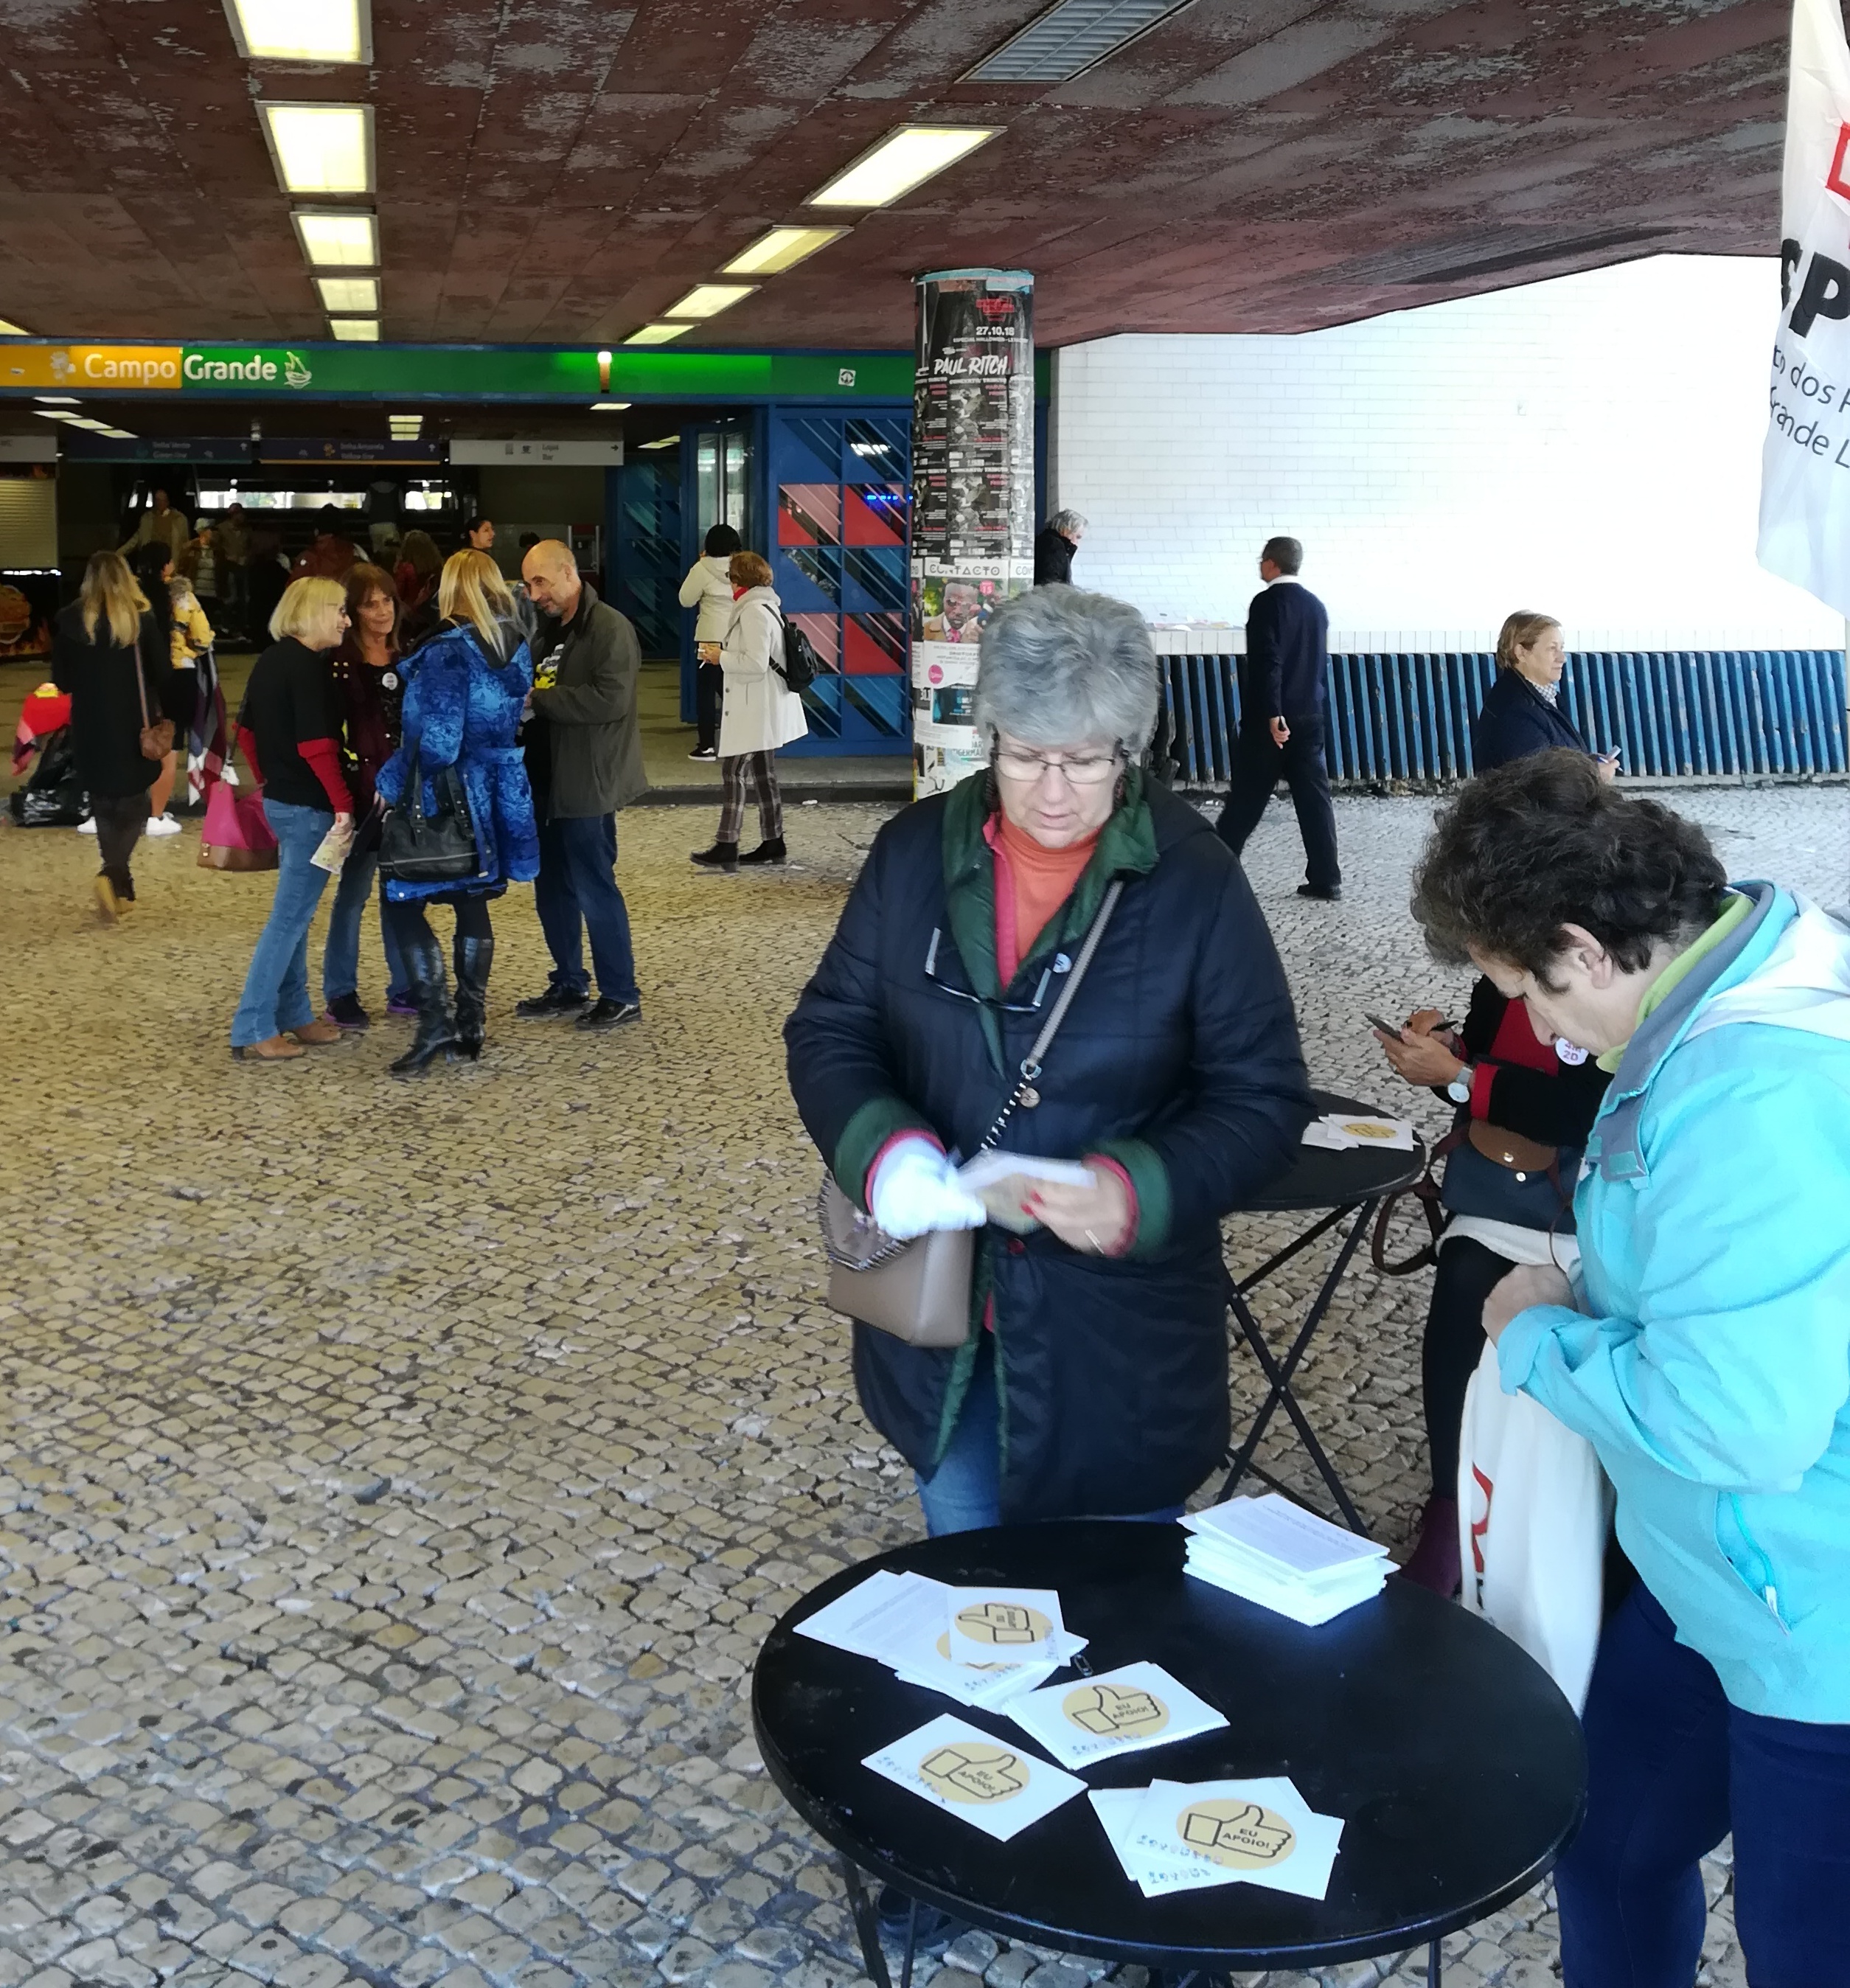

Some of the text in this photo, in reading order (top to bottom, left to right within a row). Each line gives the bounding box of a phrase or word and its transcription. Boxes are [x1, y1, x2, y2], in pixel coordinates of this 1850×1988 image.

[976, 326, 1015, 336] 27.10.18
[84, 353, 277, 386] Campo Grande
[933, 355, 1008, 375] PAUL RITCH
[1790, 362, 1836, 404] dos
[929, 564, 1000, 575] COTACTO
[1563, 1050, 1579, 1061] 2D
[976, 1770, 993, 1781] EU
[1239, 1828, 1258, 1837] EU
